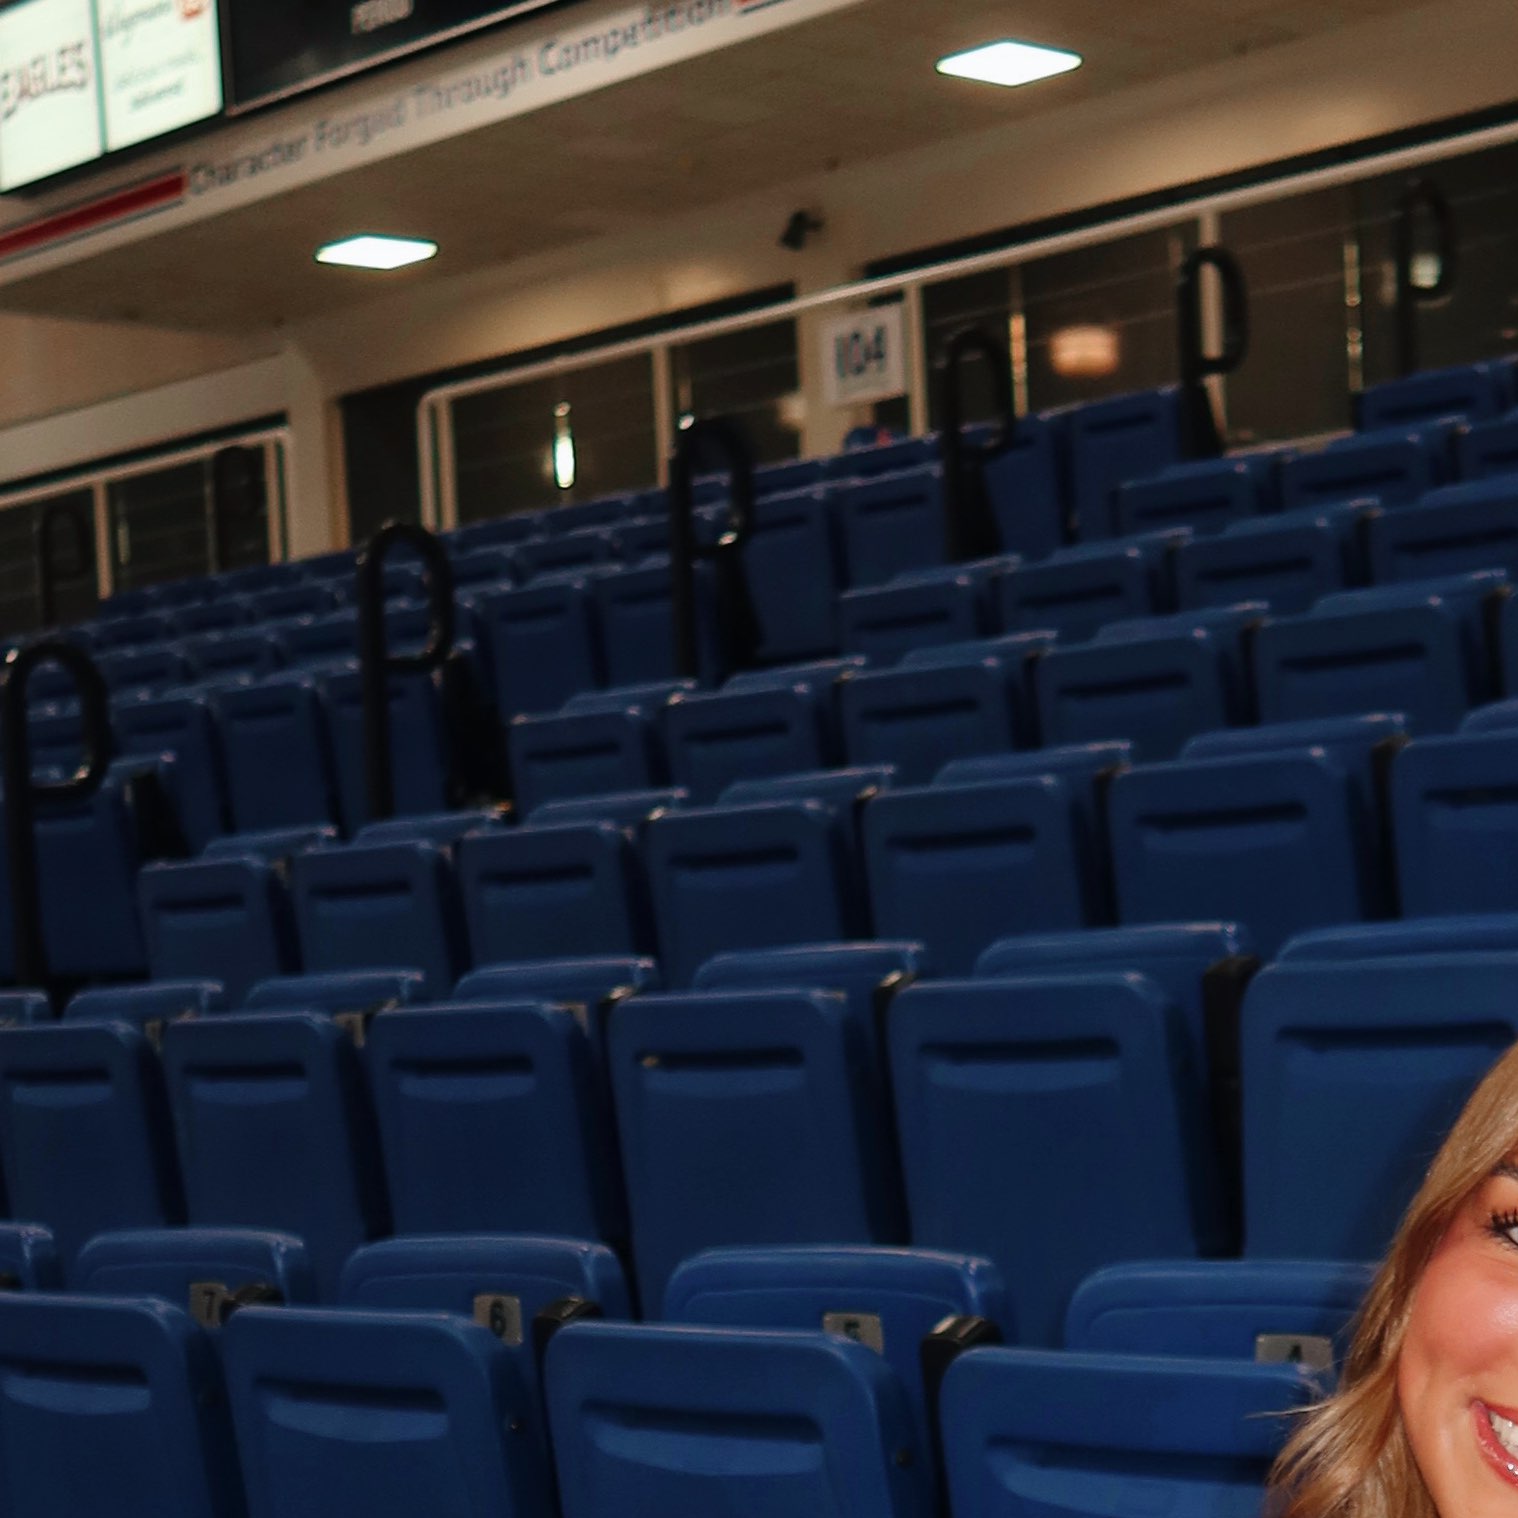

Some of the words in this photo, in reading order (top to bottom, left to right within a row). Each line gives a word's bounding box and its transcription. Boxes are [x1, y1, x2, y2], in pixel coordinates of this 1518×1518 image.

[313, 95, 408, 152] Forged
[413, 51, 533, 119] Through
[538, 0, 733, 76] Competition
[834, 324, 888, 380] 104
[489, 1298, 507, 1338] 6
